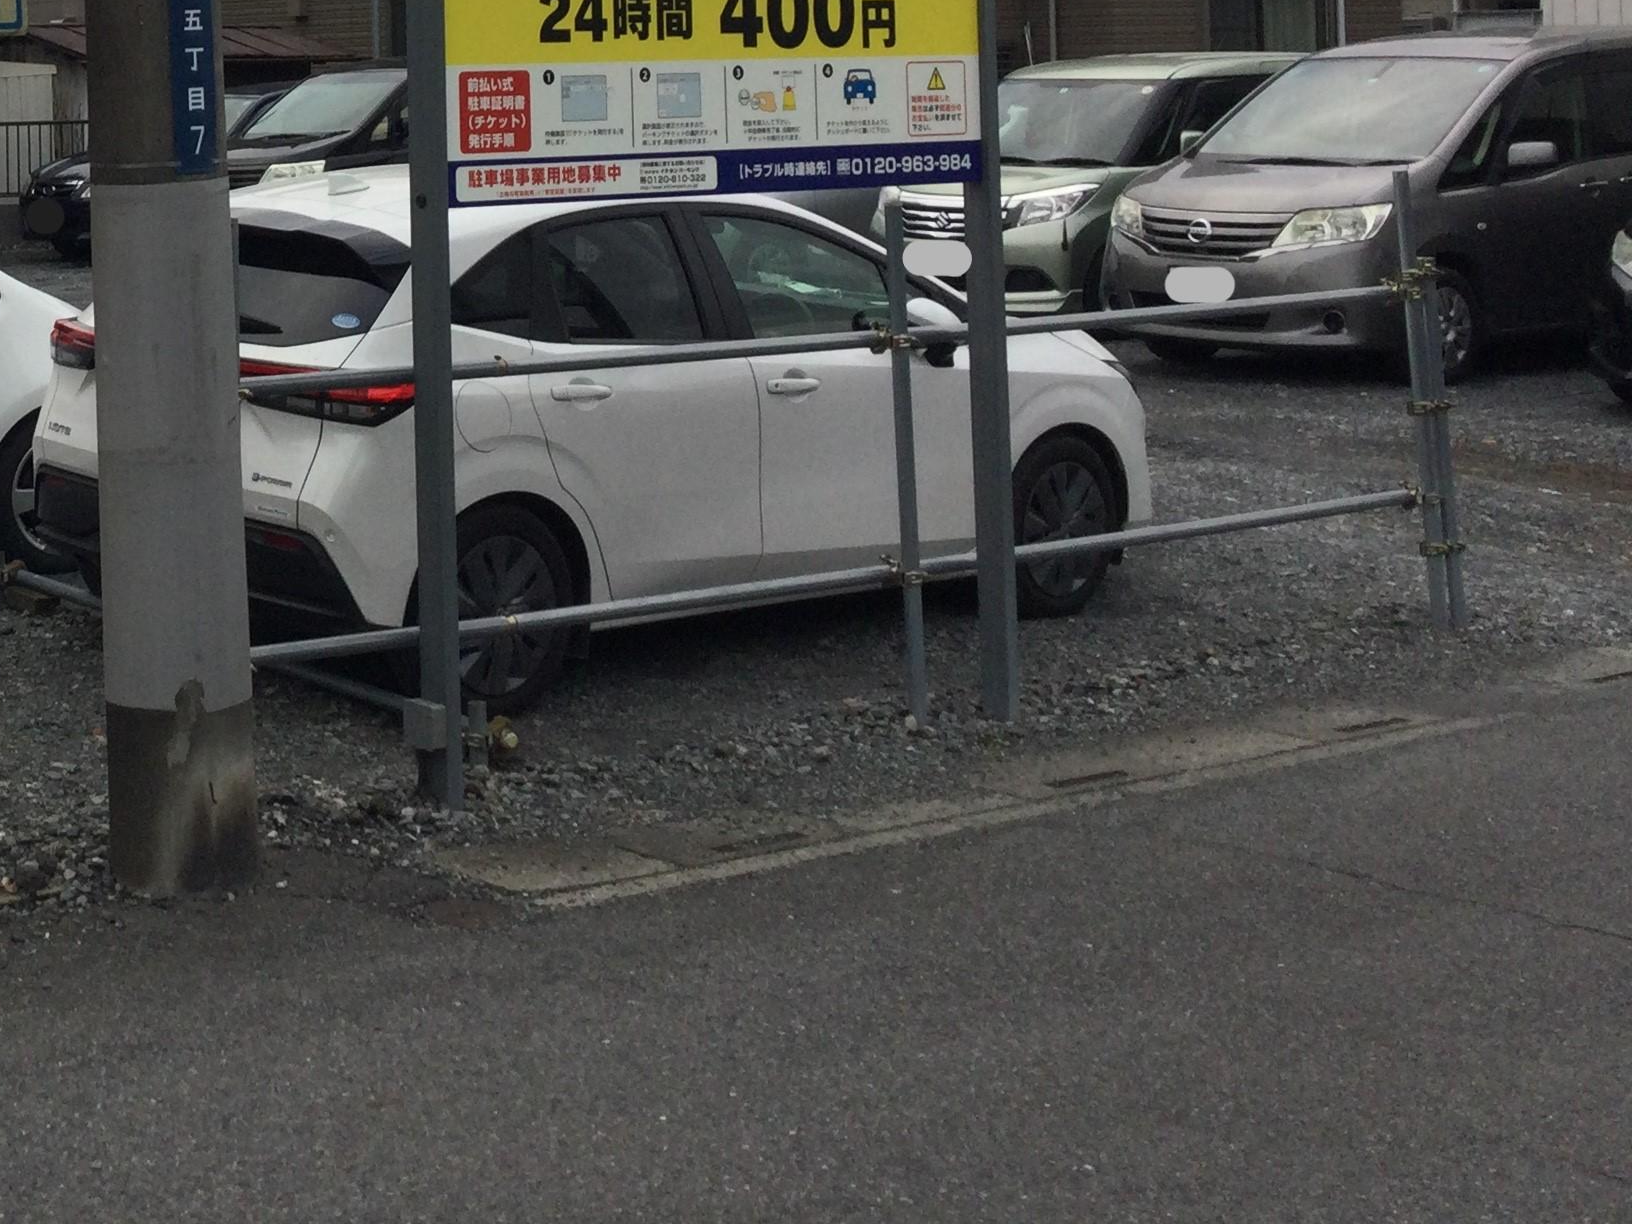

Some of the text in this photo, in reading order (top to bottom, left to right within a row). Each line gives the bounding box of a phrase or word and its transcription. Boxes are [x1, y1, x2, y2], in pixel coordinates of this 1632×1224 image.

[467, 77, 514, 92] 前払い式
[468, 95, 526, 111] 駐車証明書
[468, 133, 515, 149] 発行手順
[851, 154, 972, 175] 0120-963-984
